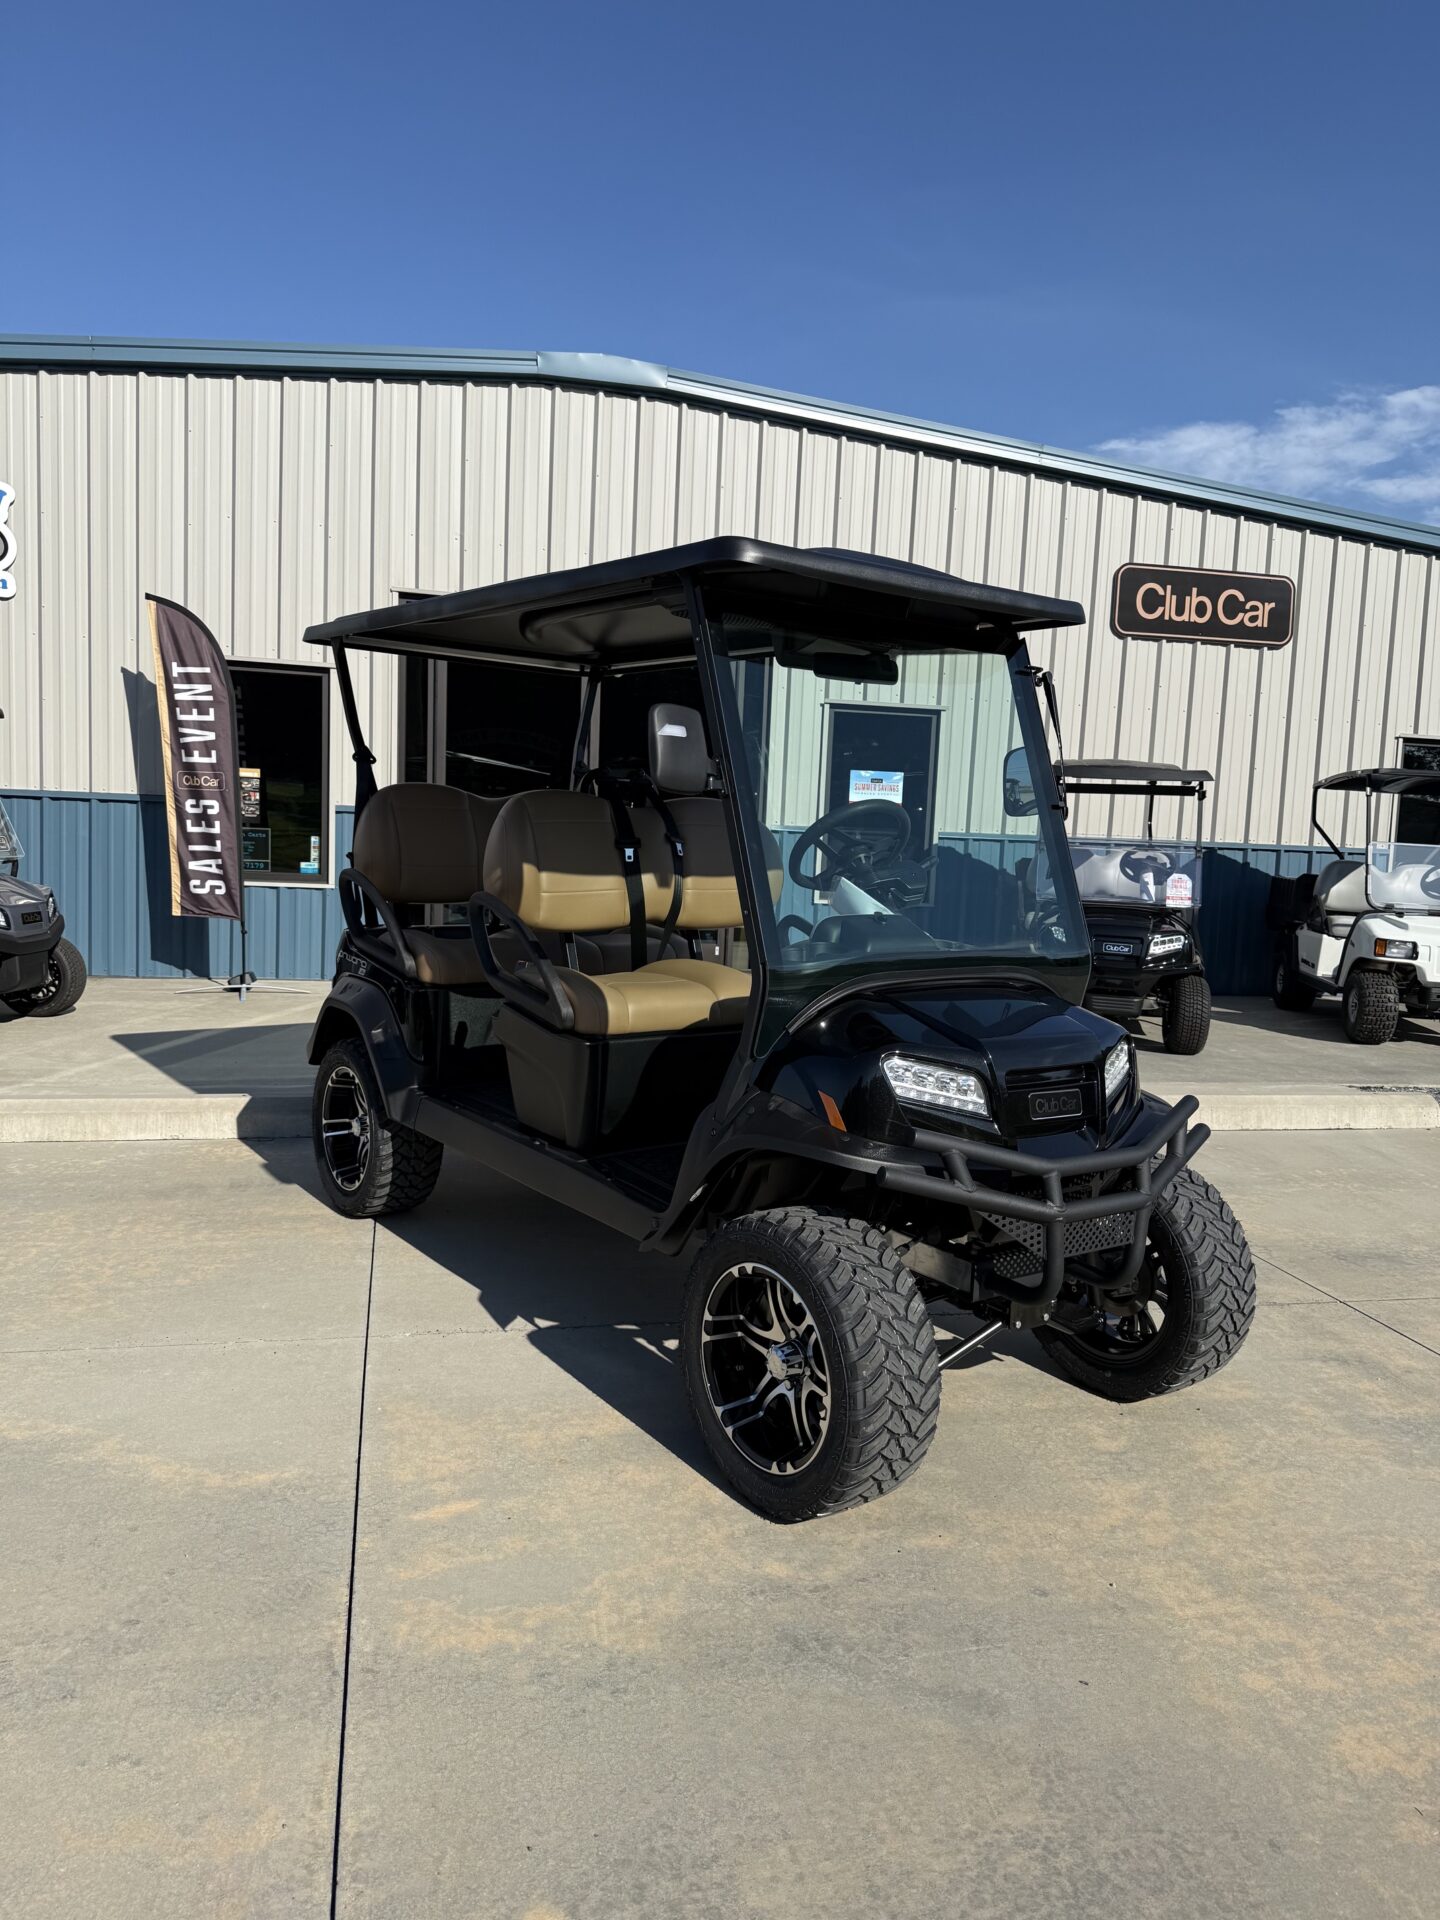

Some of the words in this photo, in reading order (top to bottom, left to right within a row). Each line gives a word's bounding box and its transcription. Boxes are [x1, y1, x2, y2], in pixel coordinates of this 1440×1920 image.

[1136, 582, 1213, 624] Club
[1216, 588, 1276, 628] Car
[172, 662, 217, 763] EVENT
[201, 775, 220, 787] Car
[185, 799, 227, 895] SALES
[1035, 1097, 1059, 1113] Club
[1059, 1096, 1077, 1111] Car
